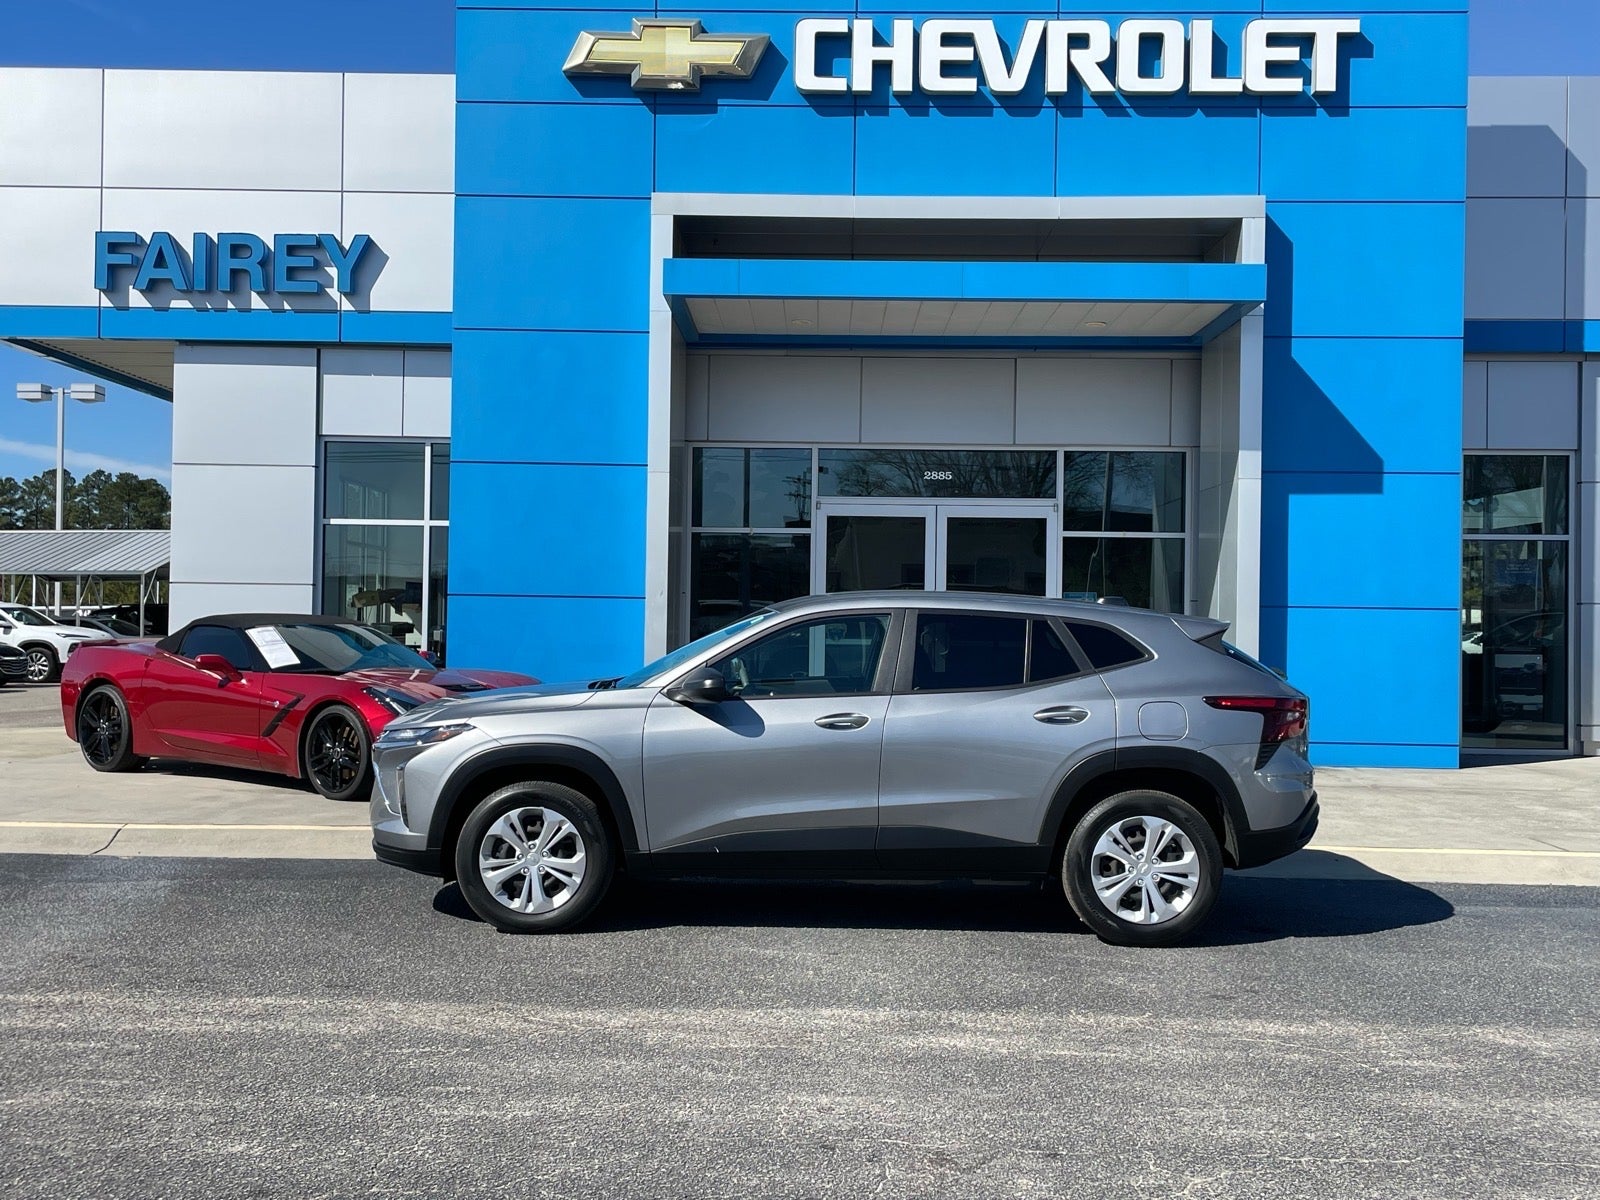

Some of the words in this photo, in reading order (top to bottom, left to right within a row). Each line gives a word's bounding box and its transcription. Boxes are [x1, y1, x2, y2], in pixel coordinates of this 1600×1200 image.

[794, 18, 1360, 95] CHEVROLET
[94, 231, 370, 294] FAIREY
[923, 471, 952, 480] 2885
